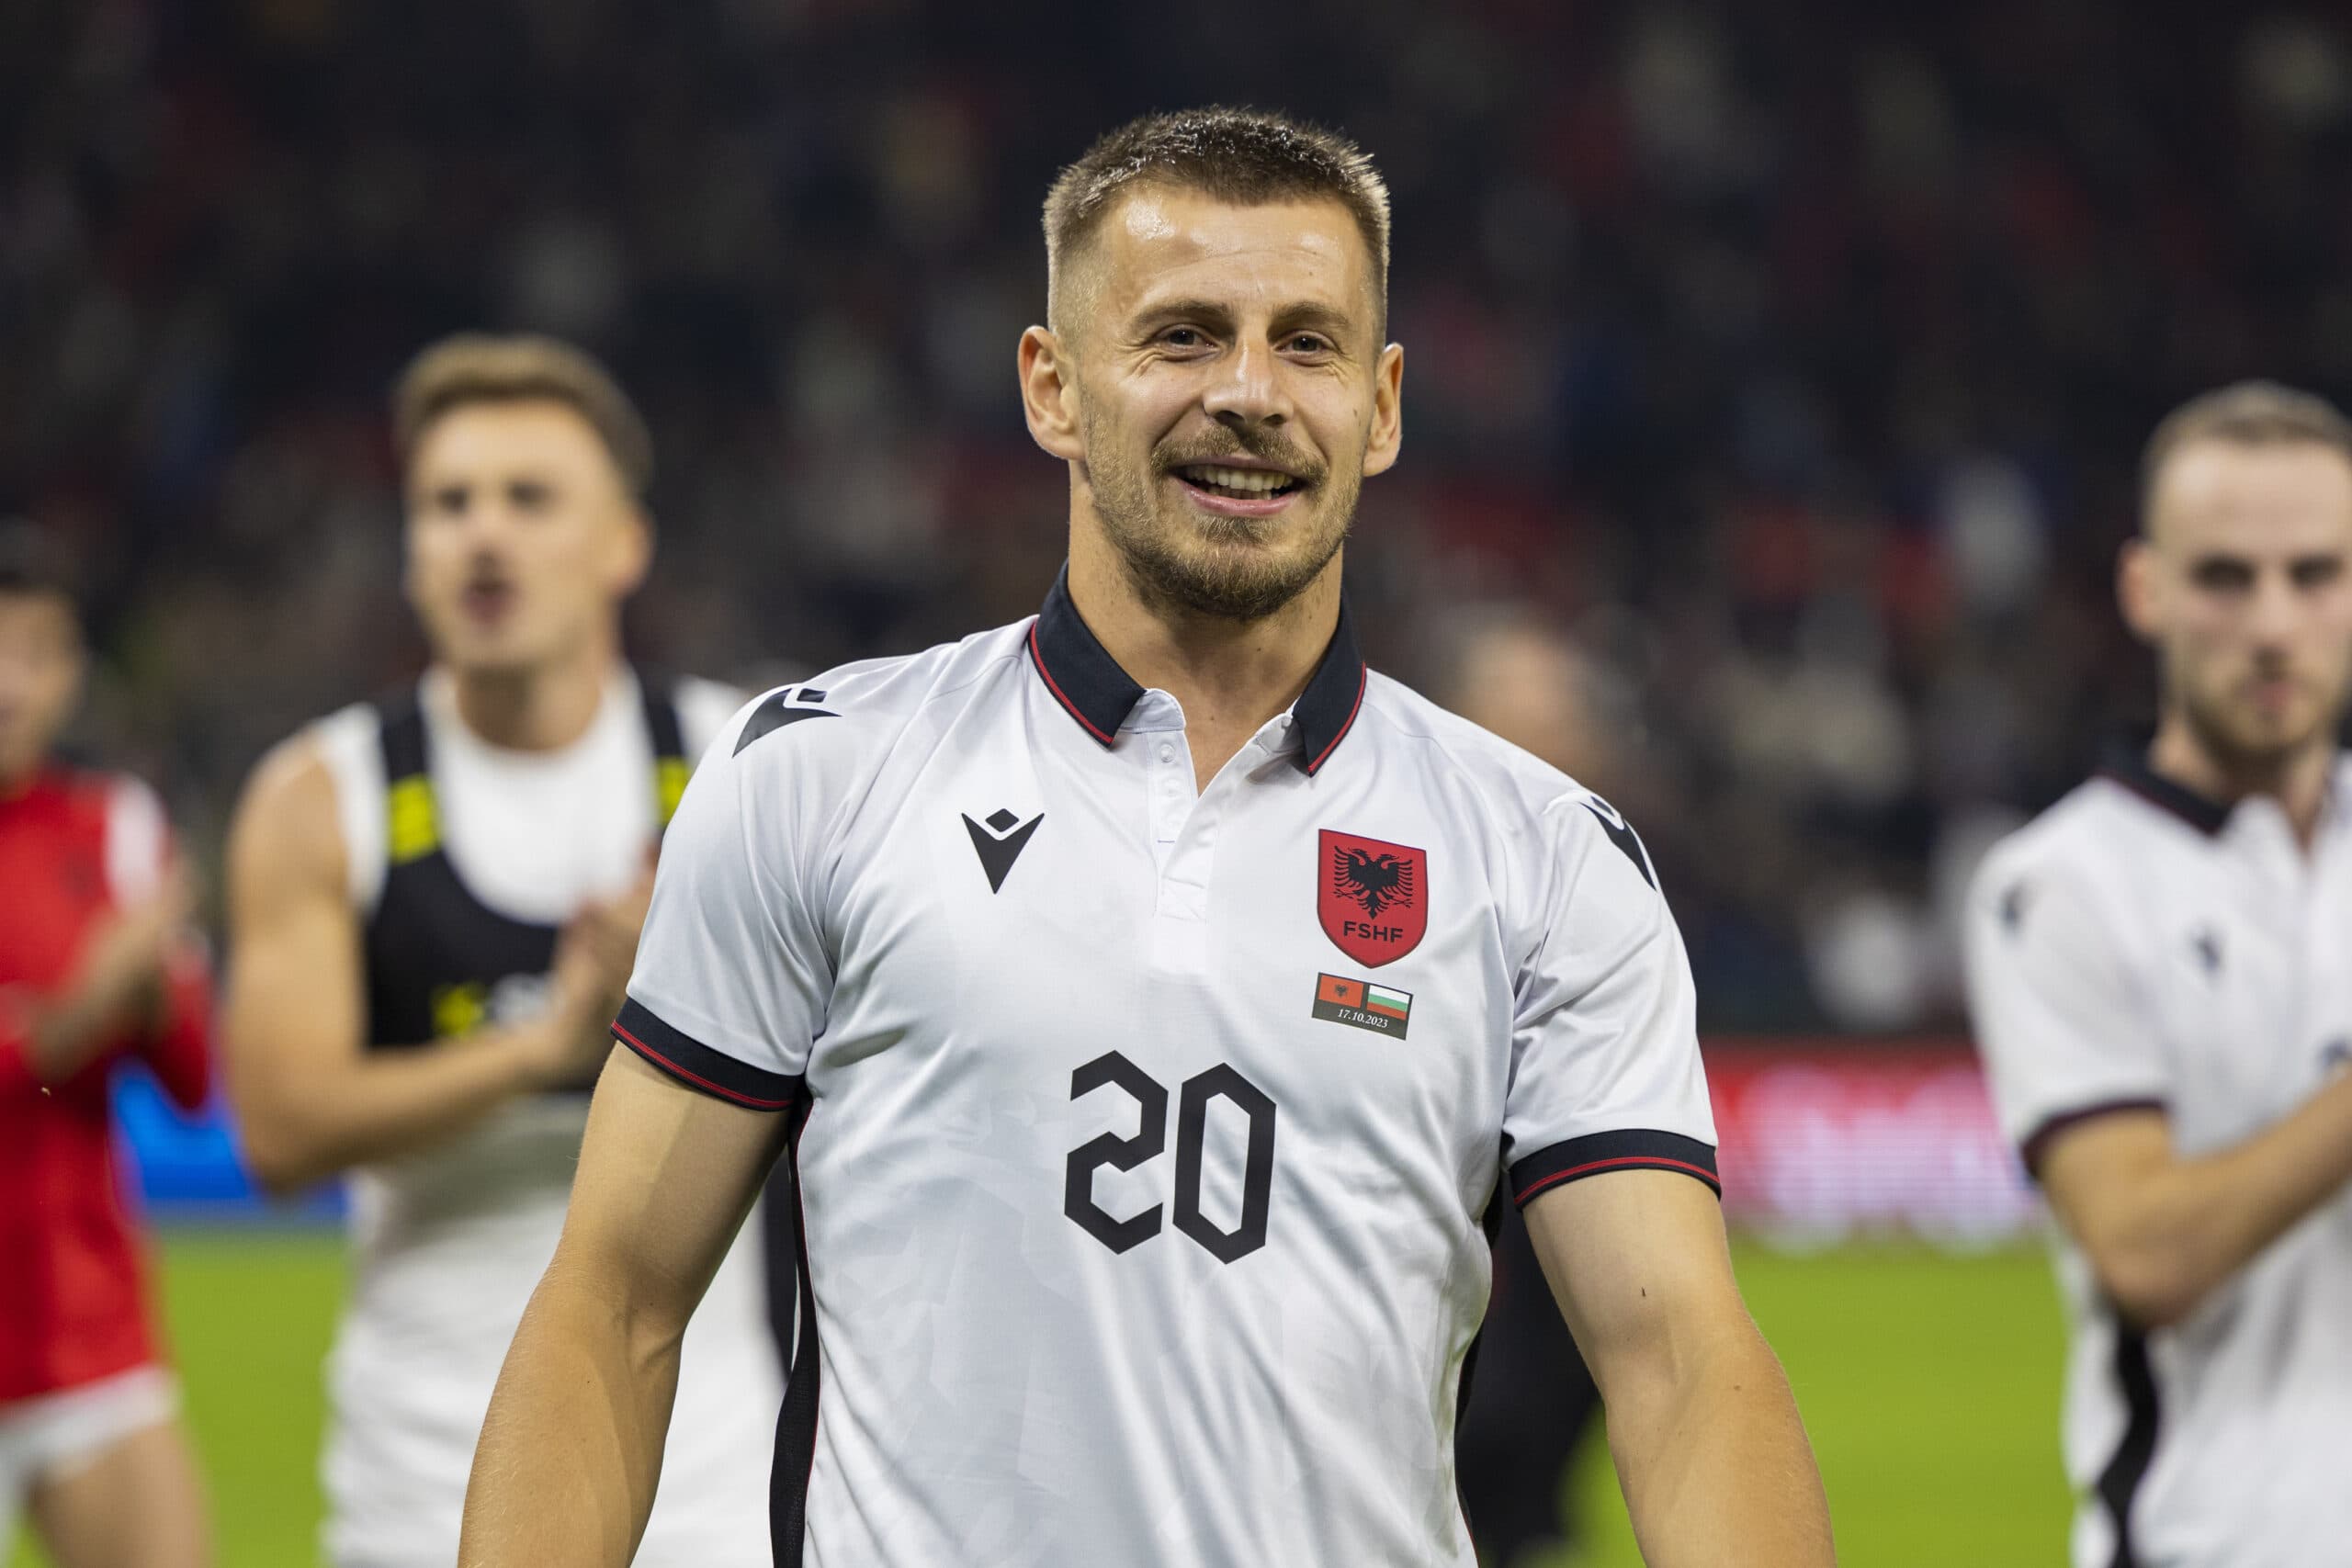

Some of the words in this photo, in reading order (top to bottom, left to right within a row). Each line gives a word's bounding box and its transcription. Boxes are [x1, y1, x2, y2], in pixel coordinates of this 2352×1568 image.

[1343, 921, 1403, 942] FSHF
[1338, 1009, 1388, 1028] 17.10.2023
[1064, 1050, 1276, 1265] 20
